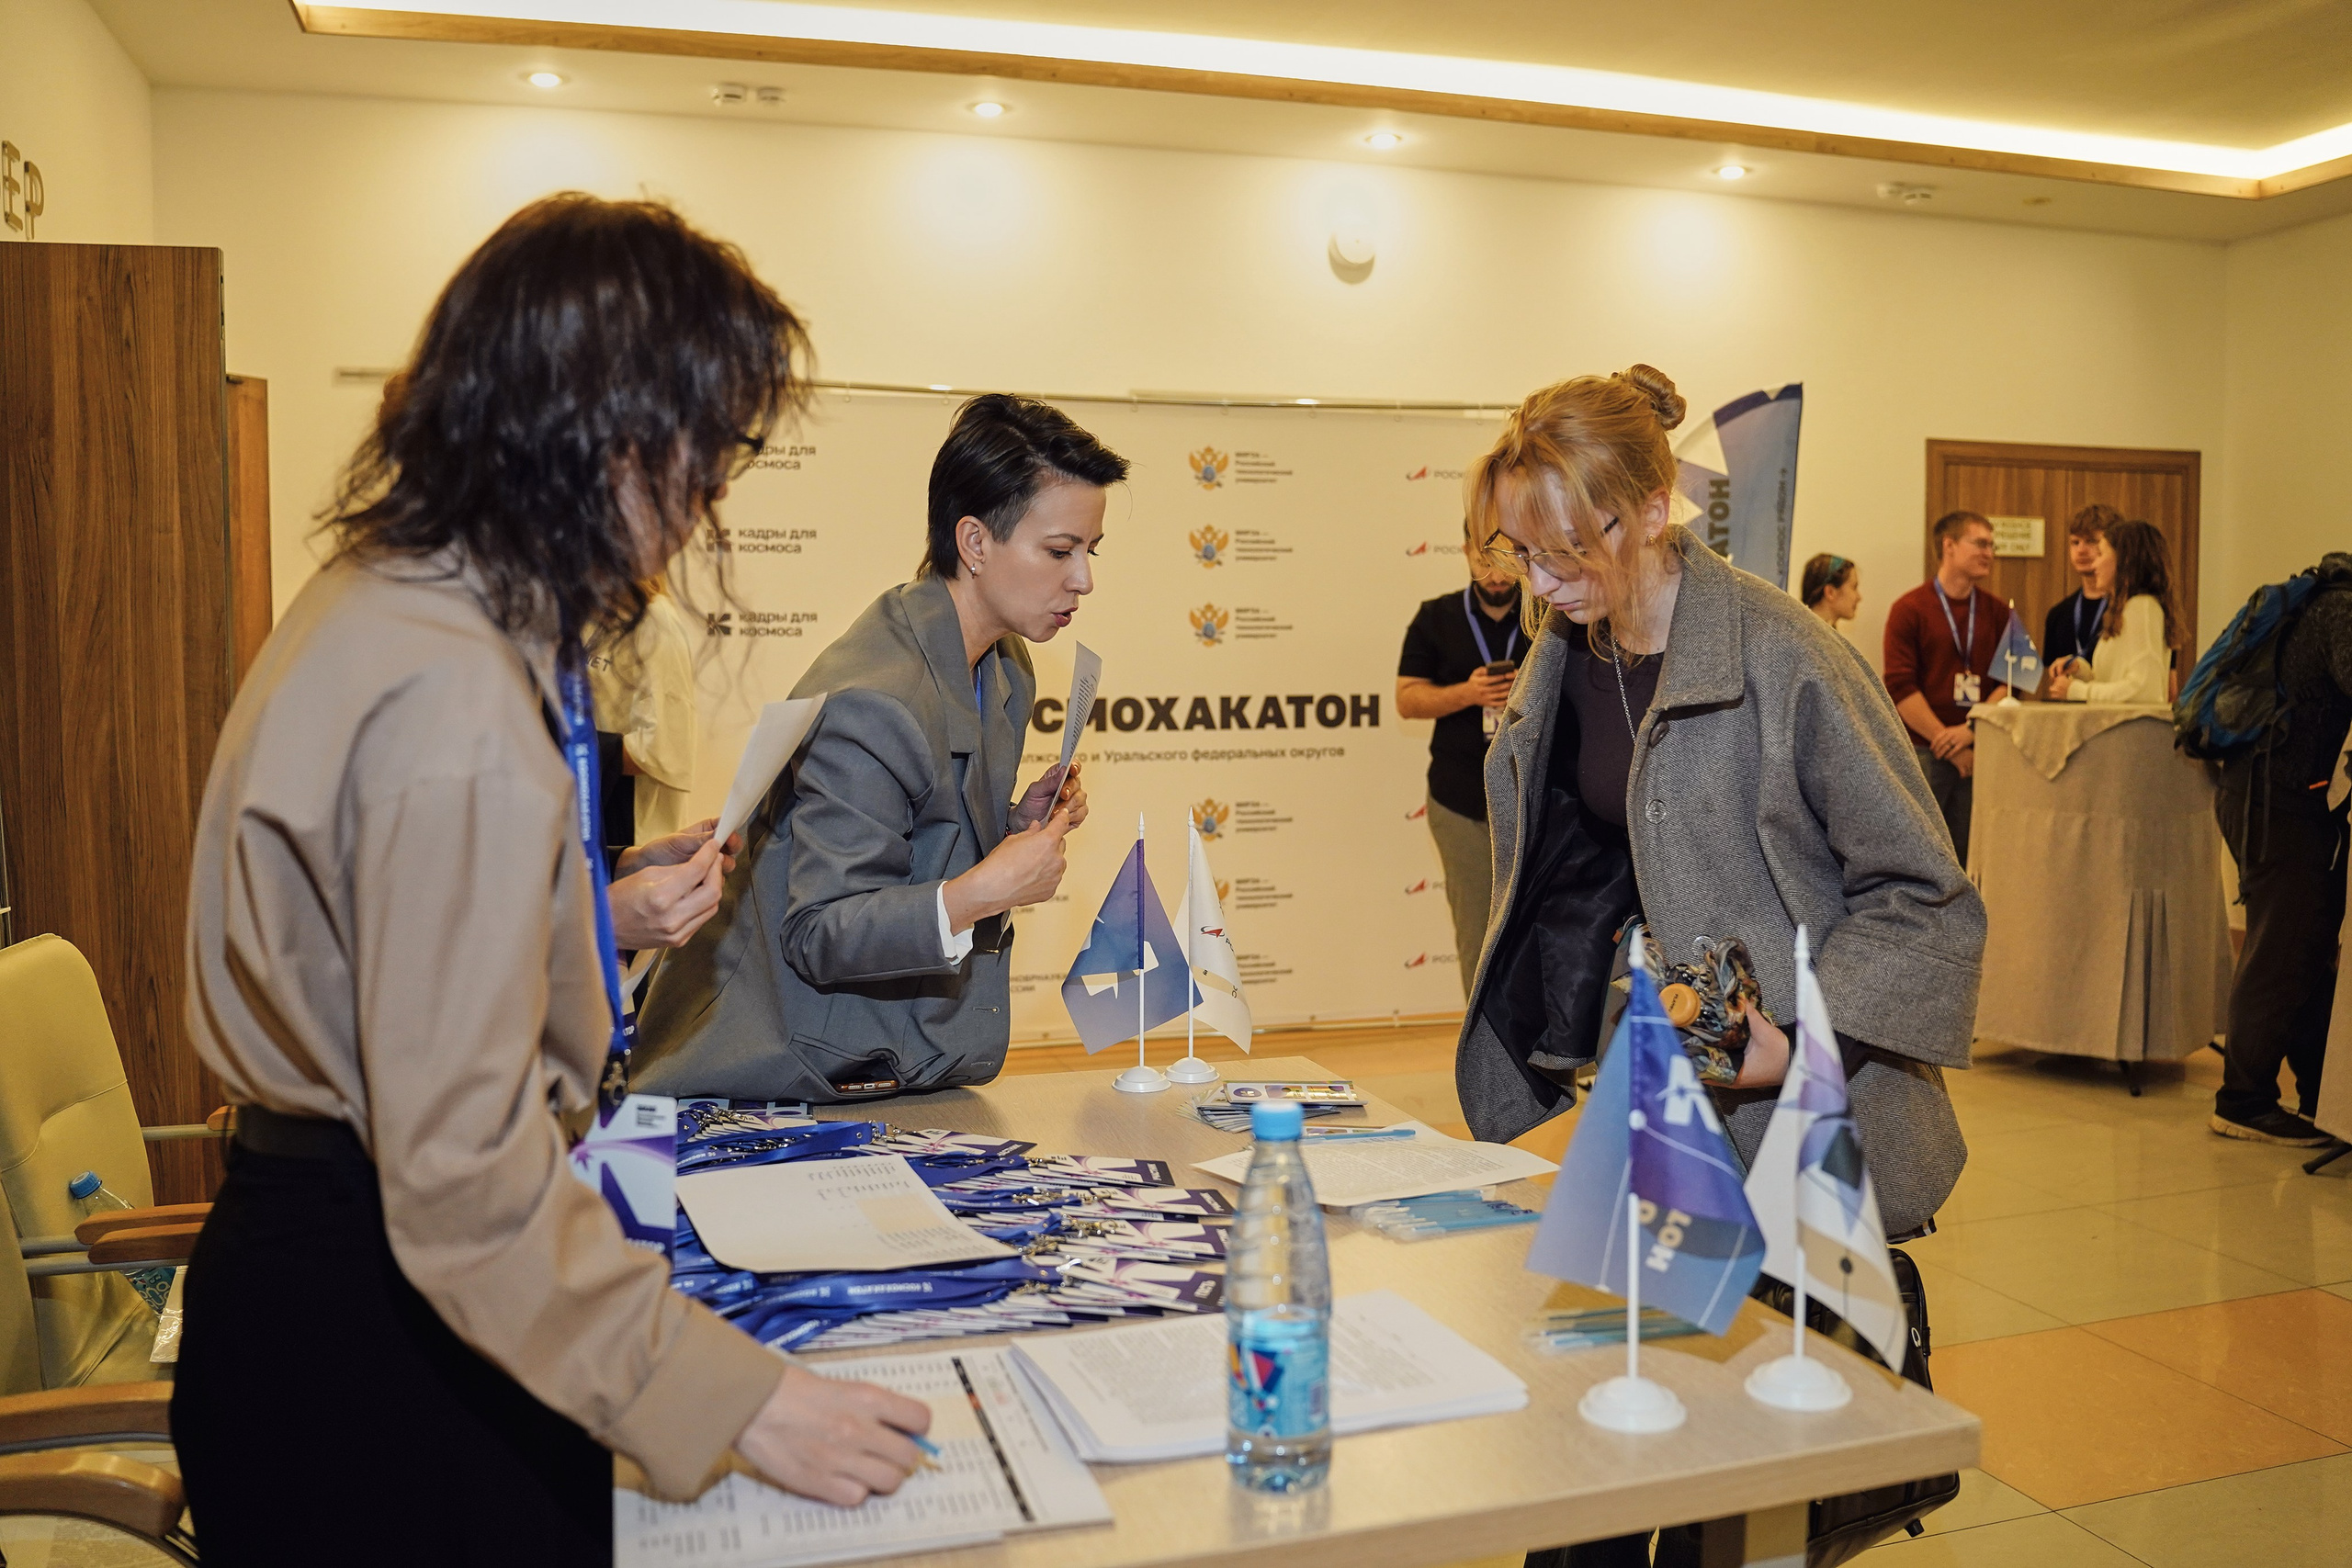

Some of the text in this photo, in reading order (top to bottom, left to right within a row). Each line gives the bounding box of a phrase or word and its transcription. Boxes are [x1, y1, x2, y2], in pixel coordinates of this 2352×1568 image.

[759, 446, 816, 457] дры для
[748, 459, 801, 470] осмоса
[739, 529, 817, 540] кадры для
[739, 544, 802, 553] космоса
[740, 613, 818, 624] кадры для
[740, 627, 803, 637] космоса
[1032, 693, 1380, 733] СОХАКАТОН
[1103, 749, 1188, 764] Уральского
[1191, 746, 1286, 762] федеральных
[1290, 745, 1345, 760] округов
